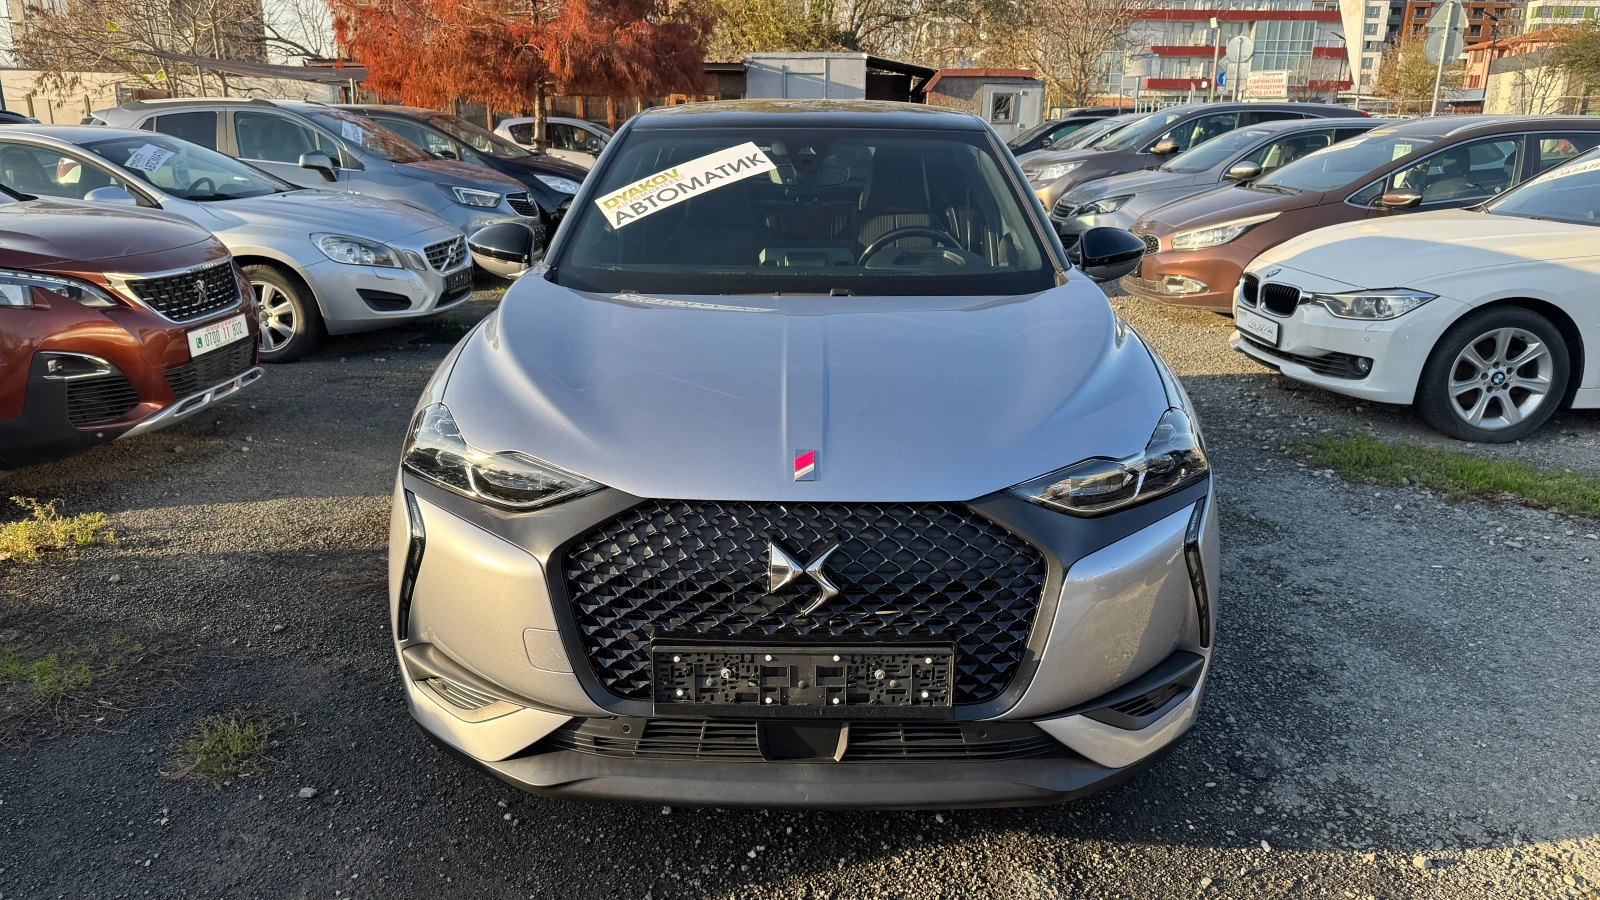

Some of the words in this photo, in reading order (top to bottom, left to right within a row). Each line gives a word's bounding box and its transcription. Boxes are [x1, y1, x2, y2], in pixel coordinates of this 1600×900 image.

[602, 168, 680, 210] DYAKOV
[615, 153, 767, 226] АВТОМАТИК
[617, 177, 680, 210] AUTOMOBILES
[204, 330, 221, 347] 0700
[223, 326, 230, 340] 11
